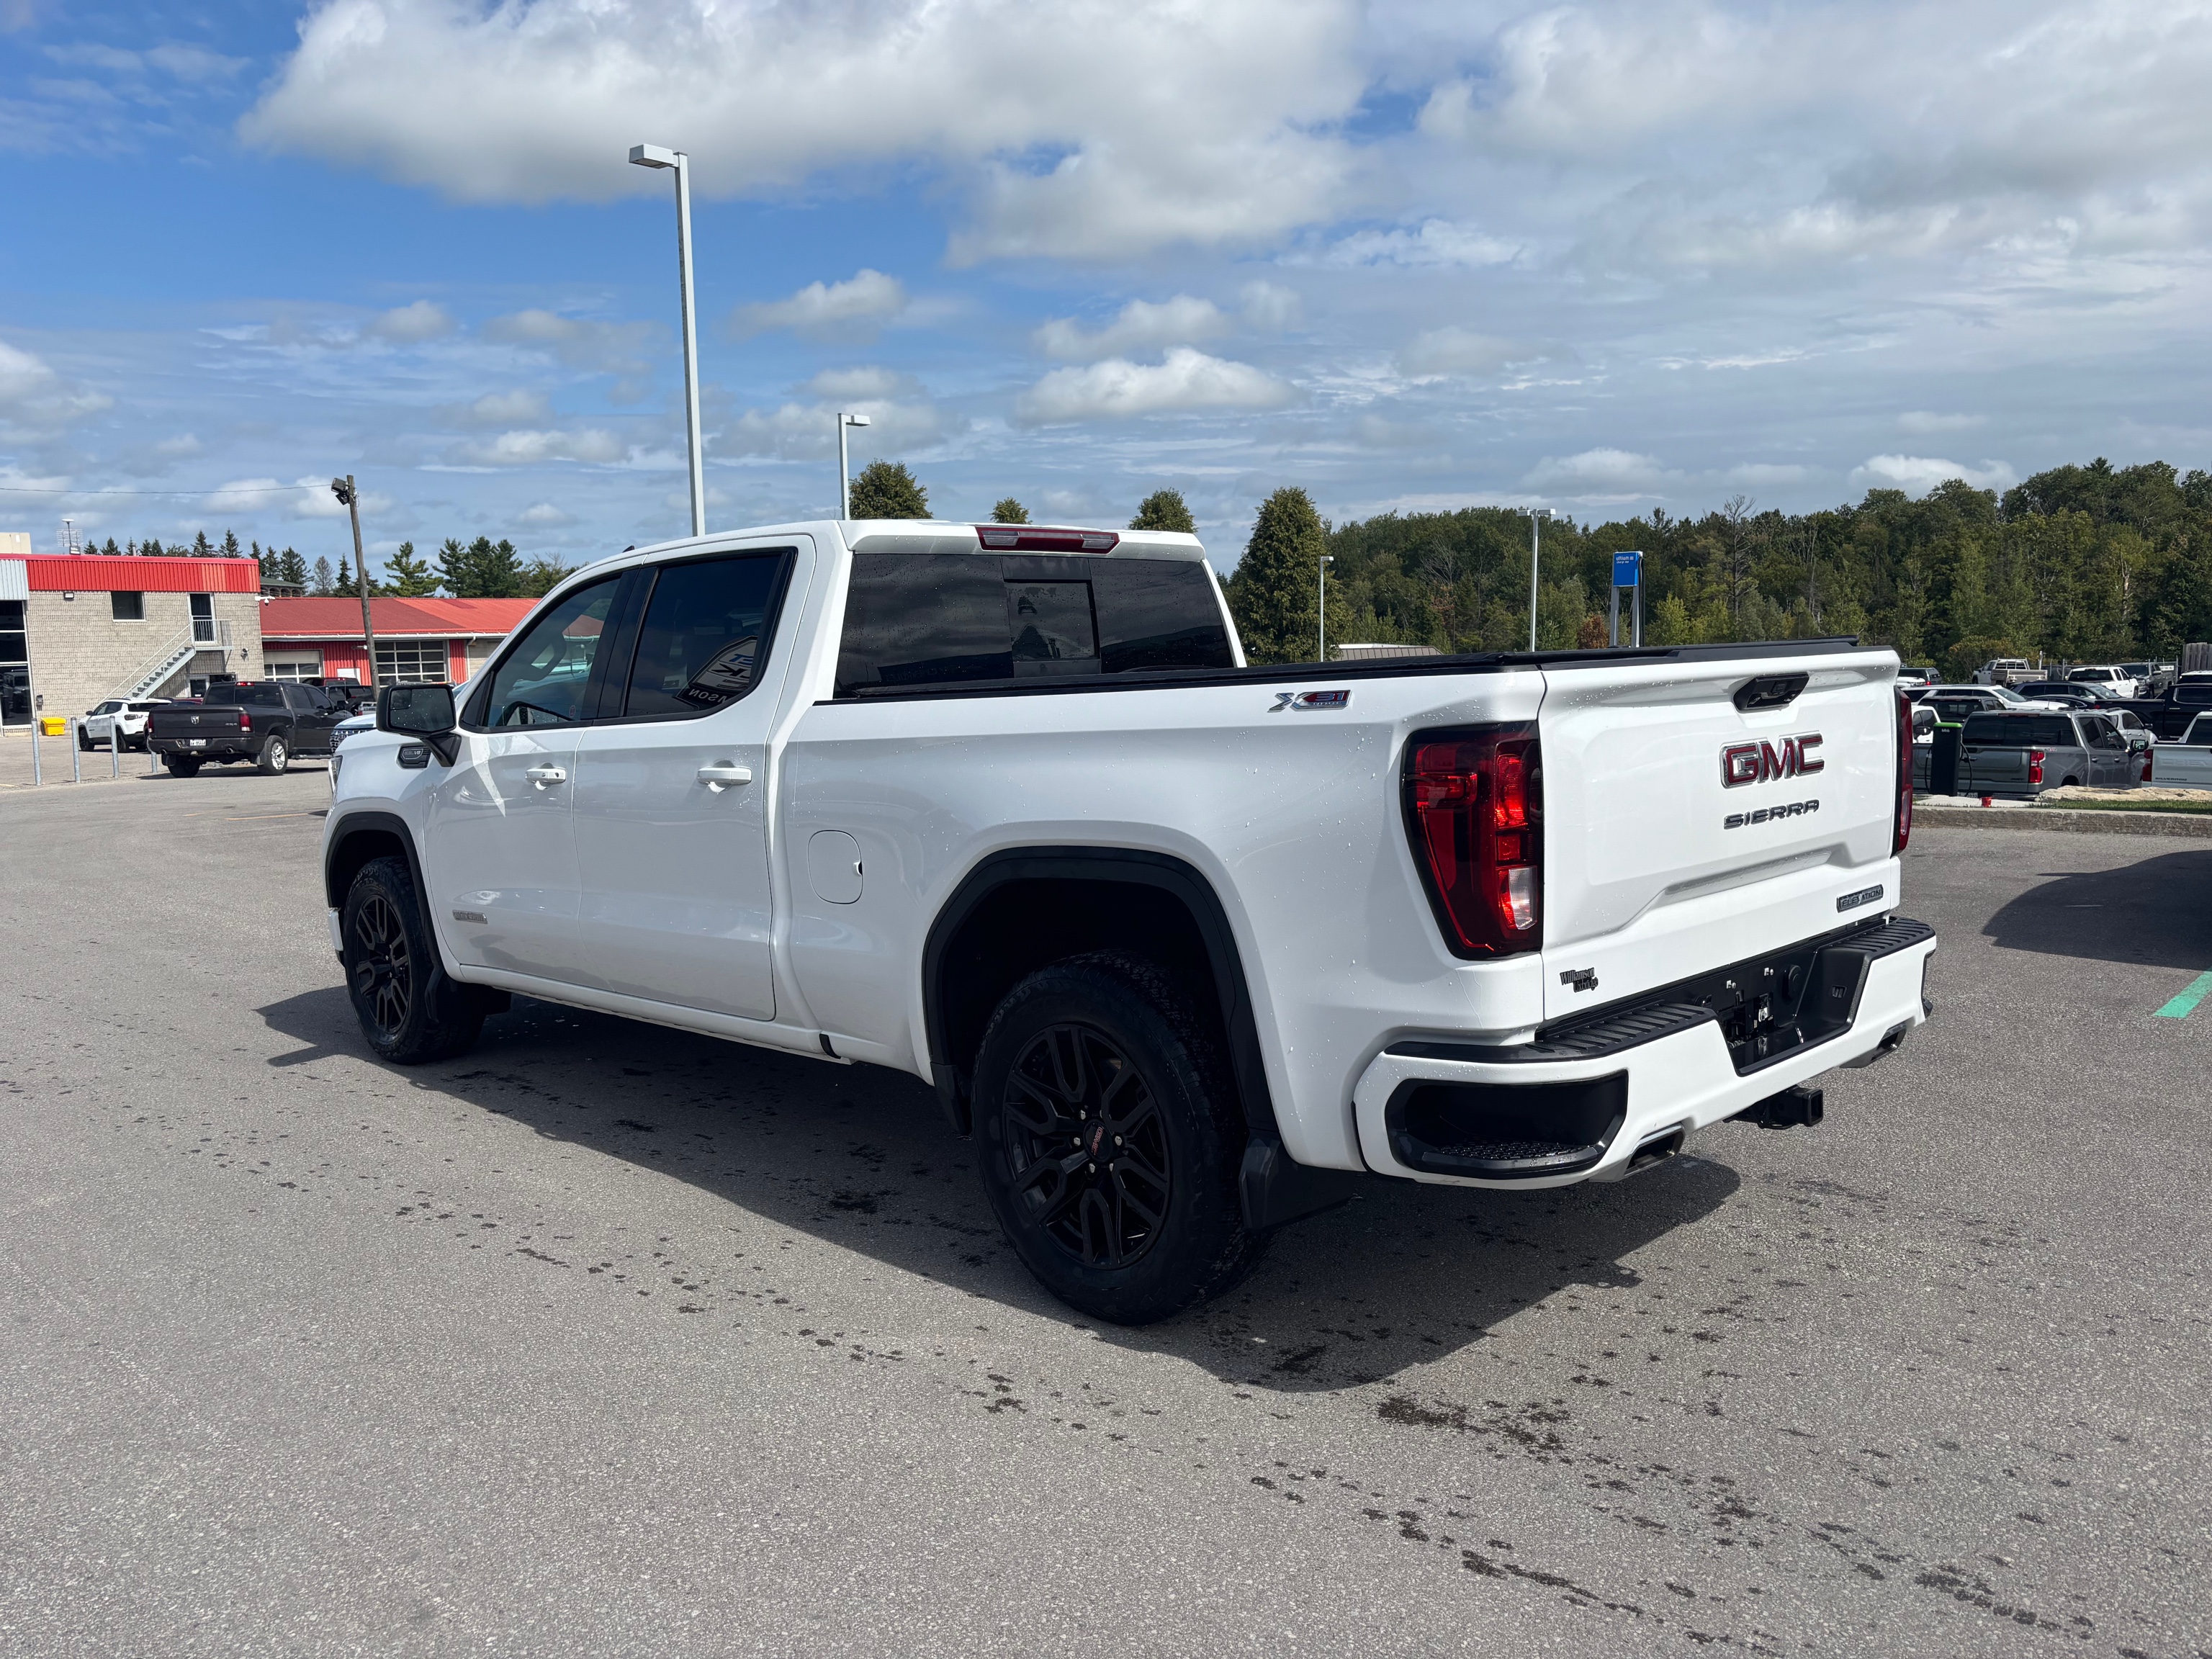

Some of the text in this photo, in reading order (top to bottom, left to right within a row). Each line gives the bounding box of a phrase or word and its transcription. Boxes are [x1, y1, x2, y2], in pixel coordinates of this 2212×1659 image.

[1267, 690, 1351, 713] X31
[1719, 731, 1825, 789] GMC
[1724, 799, 1820, 830] SIERRA
[1841, 889, 1881, 907] ELEVATION
[1560, 967, 1595, 985] Williamson
[1573, 977, 1599, 992] Uxbridge
